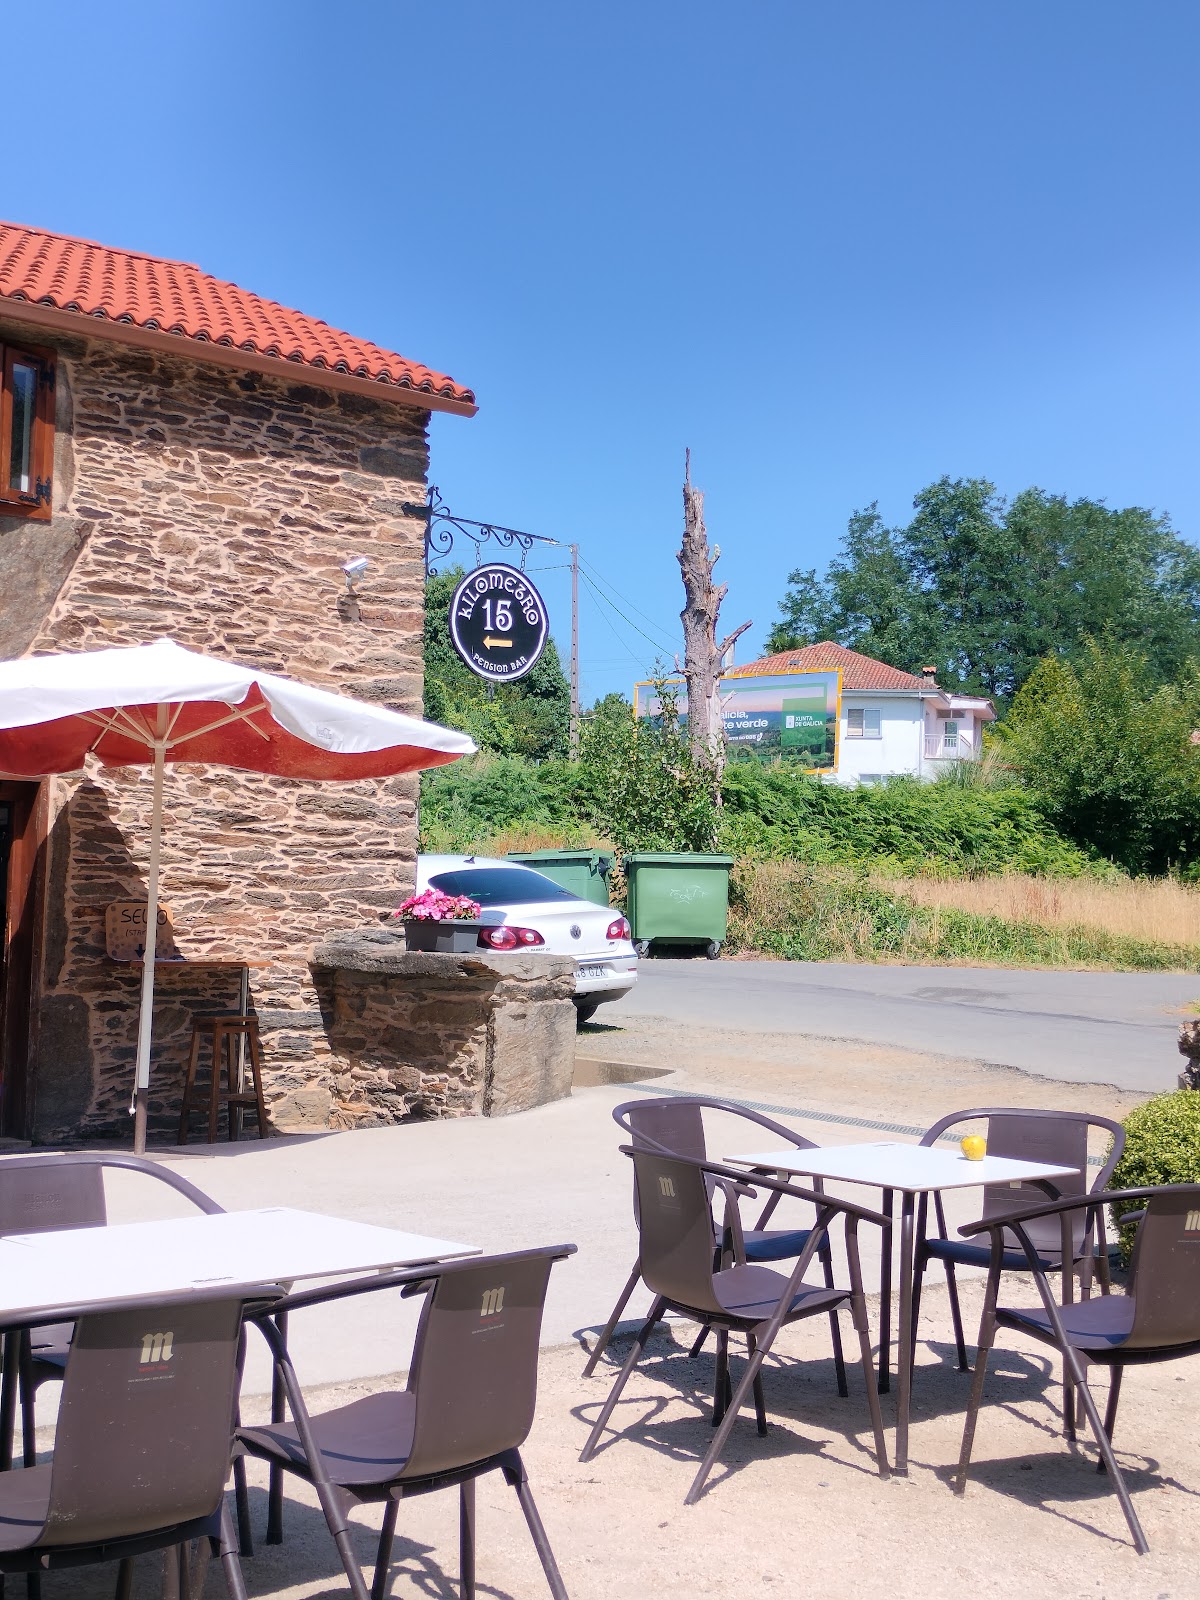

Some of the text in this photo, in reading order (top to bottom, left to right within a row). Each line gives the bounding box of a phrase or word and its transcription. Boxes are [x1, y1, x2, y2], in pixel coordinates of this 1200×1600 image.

[482, 599, 513, 631] 15
[473, 653, 528, 672] PENSION BAR
[720, 711, 749, 719] alicia,
[736, 719, 769, 728] verde
[120, 908, 168, 926] SELO
